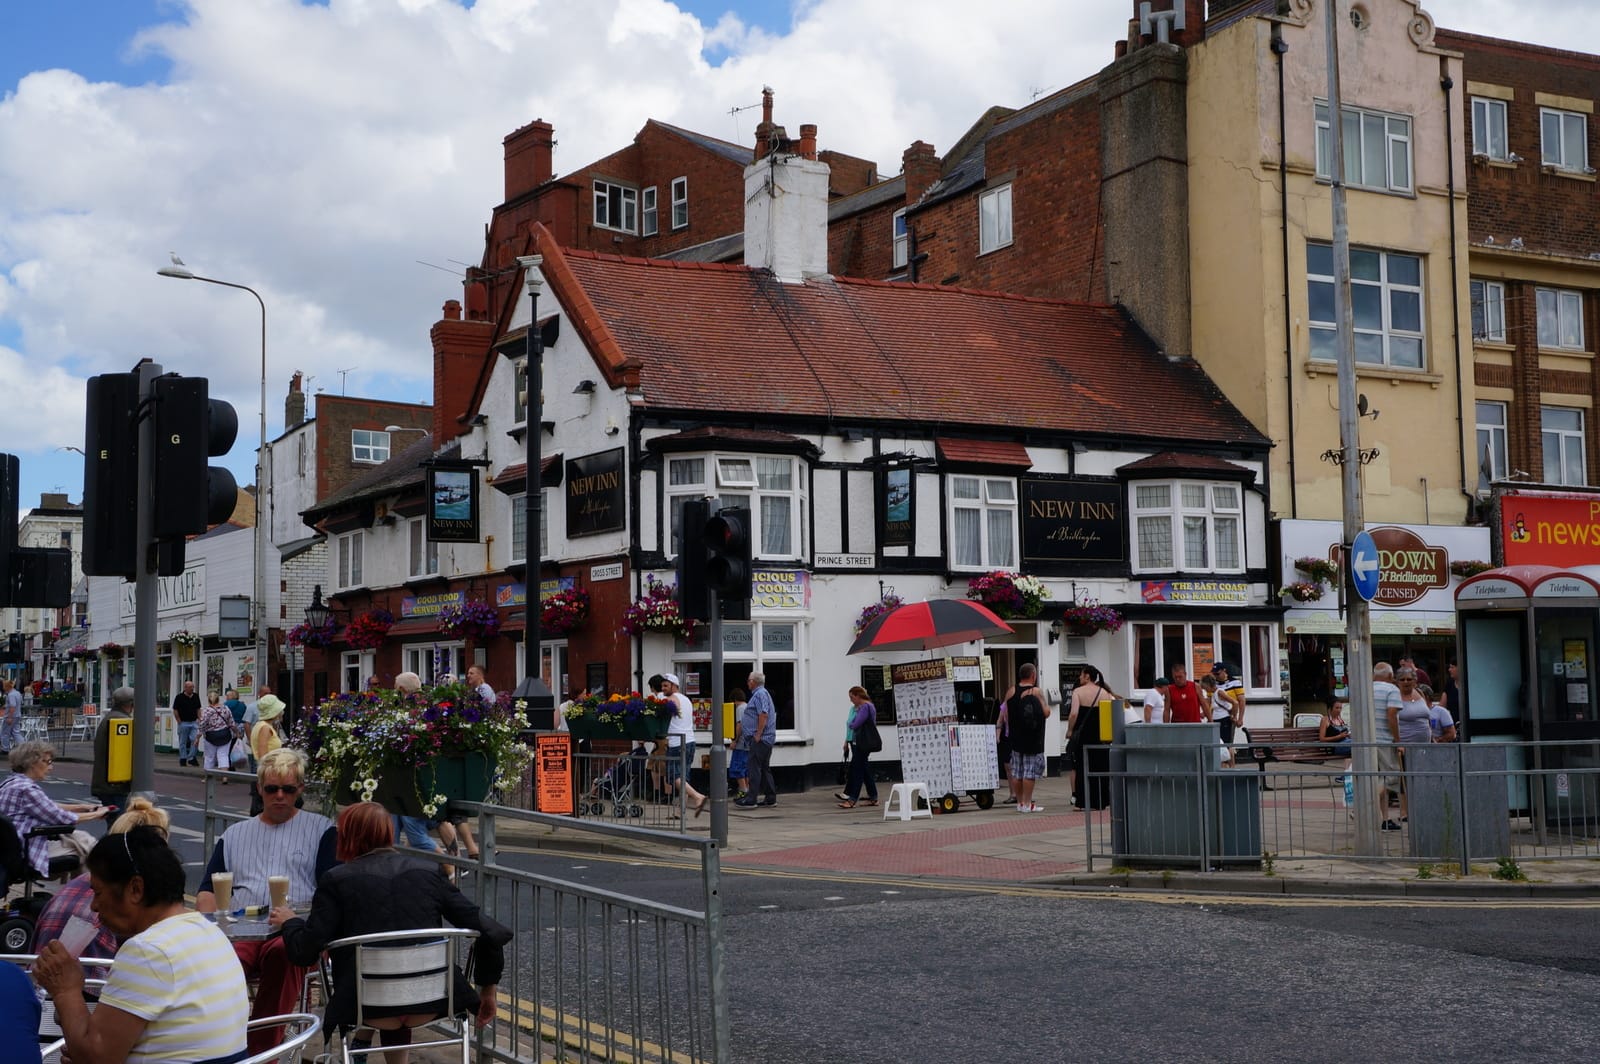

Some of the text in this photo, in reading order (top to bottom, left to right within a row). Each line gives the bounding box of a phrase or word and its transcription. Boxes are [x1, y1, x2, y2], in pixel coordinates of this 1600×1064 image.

[171, 434, 180, 444] G
[100, 450, 107, 459] E
[571, 471, 618, 496] NEW INN
[1030, 500, 1115, 520] NEW INN
[432, 520, 473, 528] NEW INN
[1057, 526, 1101, 550] Bridlington
[817, 556, 872, 565] PRINCE STREET
[1378, 550, 1436, 570] DOWN
[592, 566, 621, 577] CROSS STREET
[752, 572, 796, 582] ICIOUS
[1390, 571, 1437, 585] Bridlington
[173, 570, 197, 605] CAFE
[1171, 582, 1248, 591] THE EAST COAST
[1475, 584, 1507, 594] Telephone
[1549, 582, 1580, 592] Telephone
[416, 594, 437, 604] GOOD
[438, 592, 459, 602] FOOD
[1192, 592, 1234, 601] KARAOKE
[1376, 587, 1417, 599] ICENSED
[902, 667, 942, 680] TATTOOS
[118, 725, 127, 735] G
